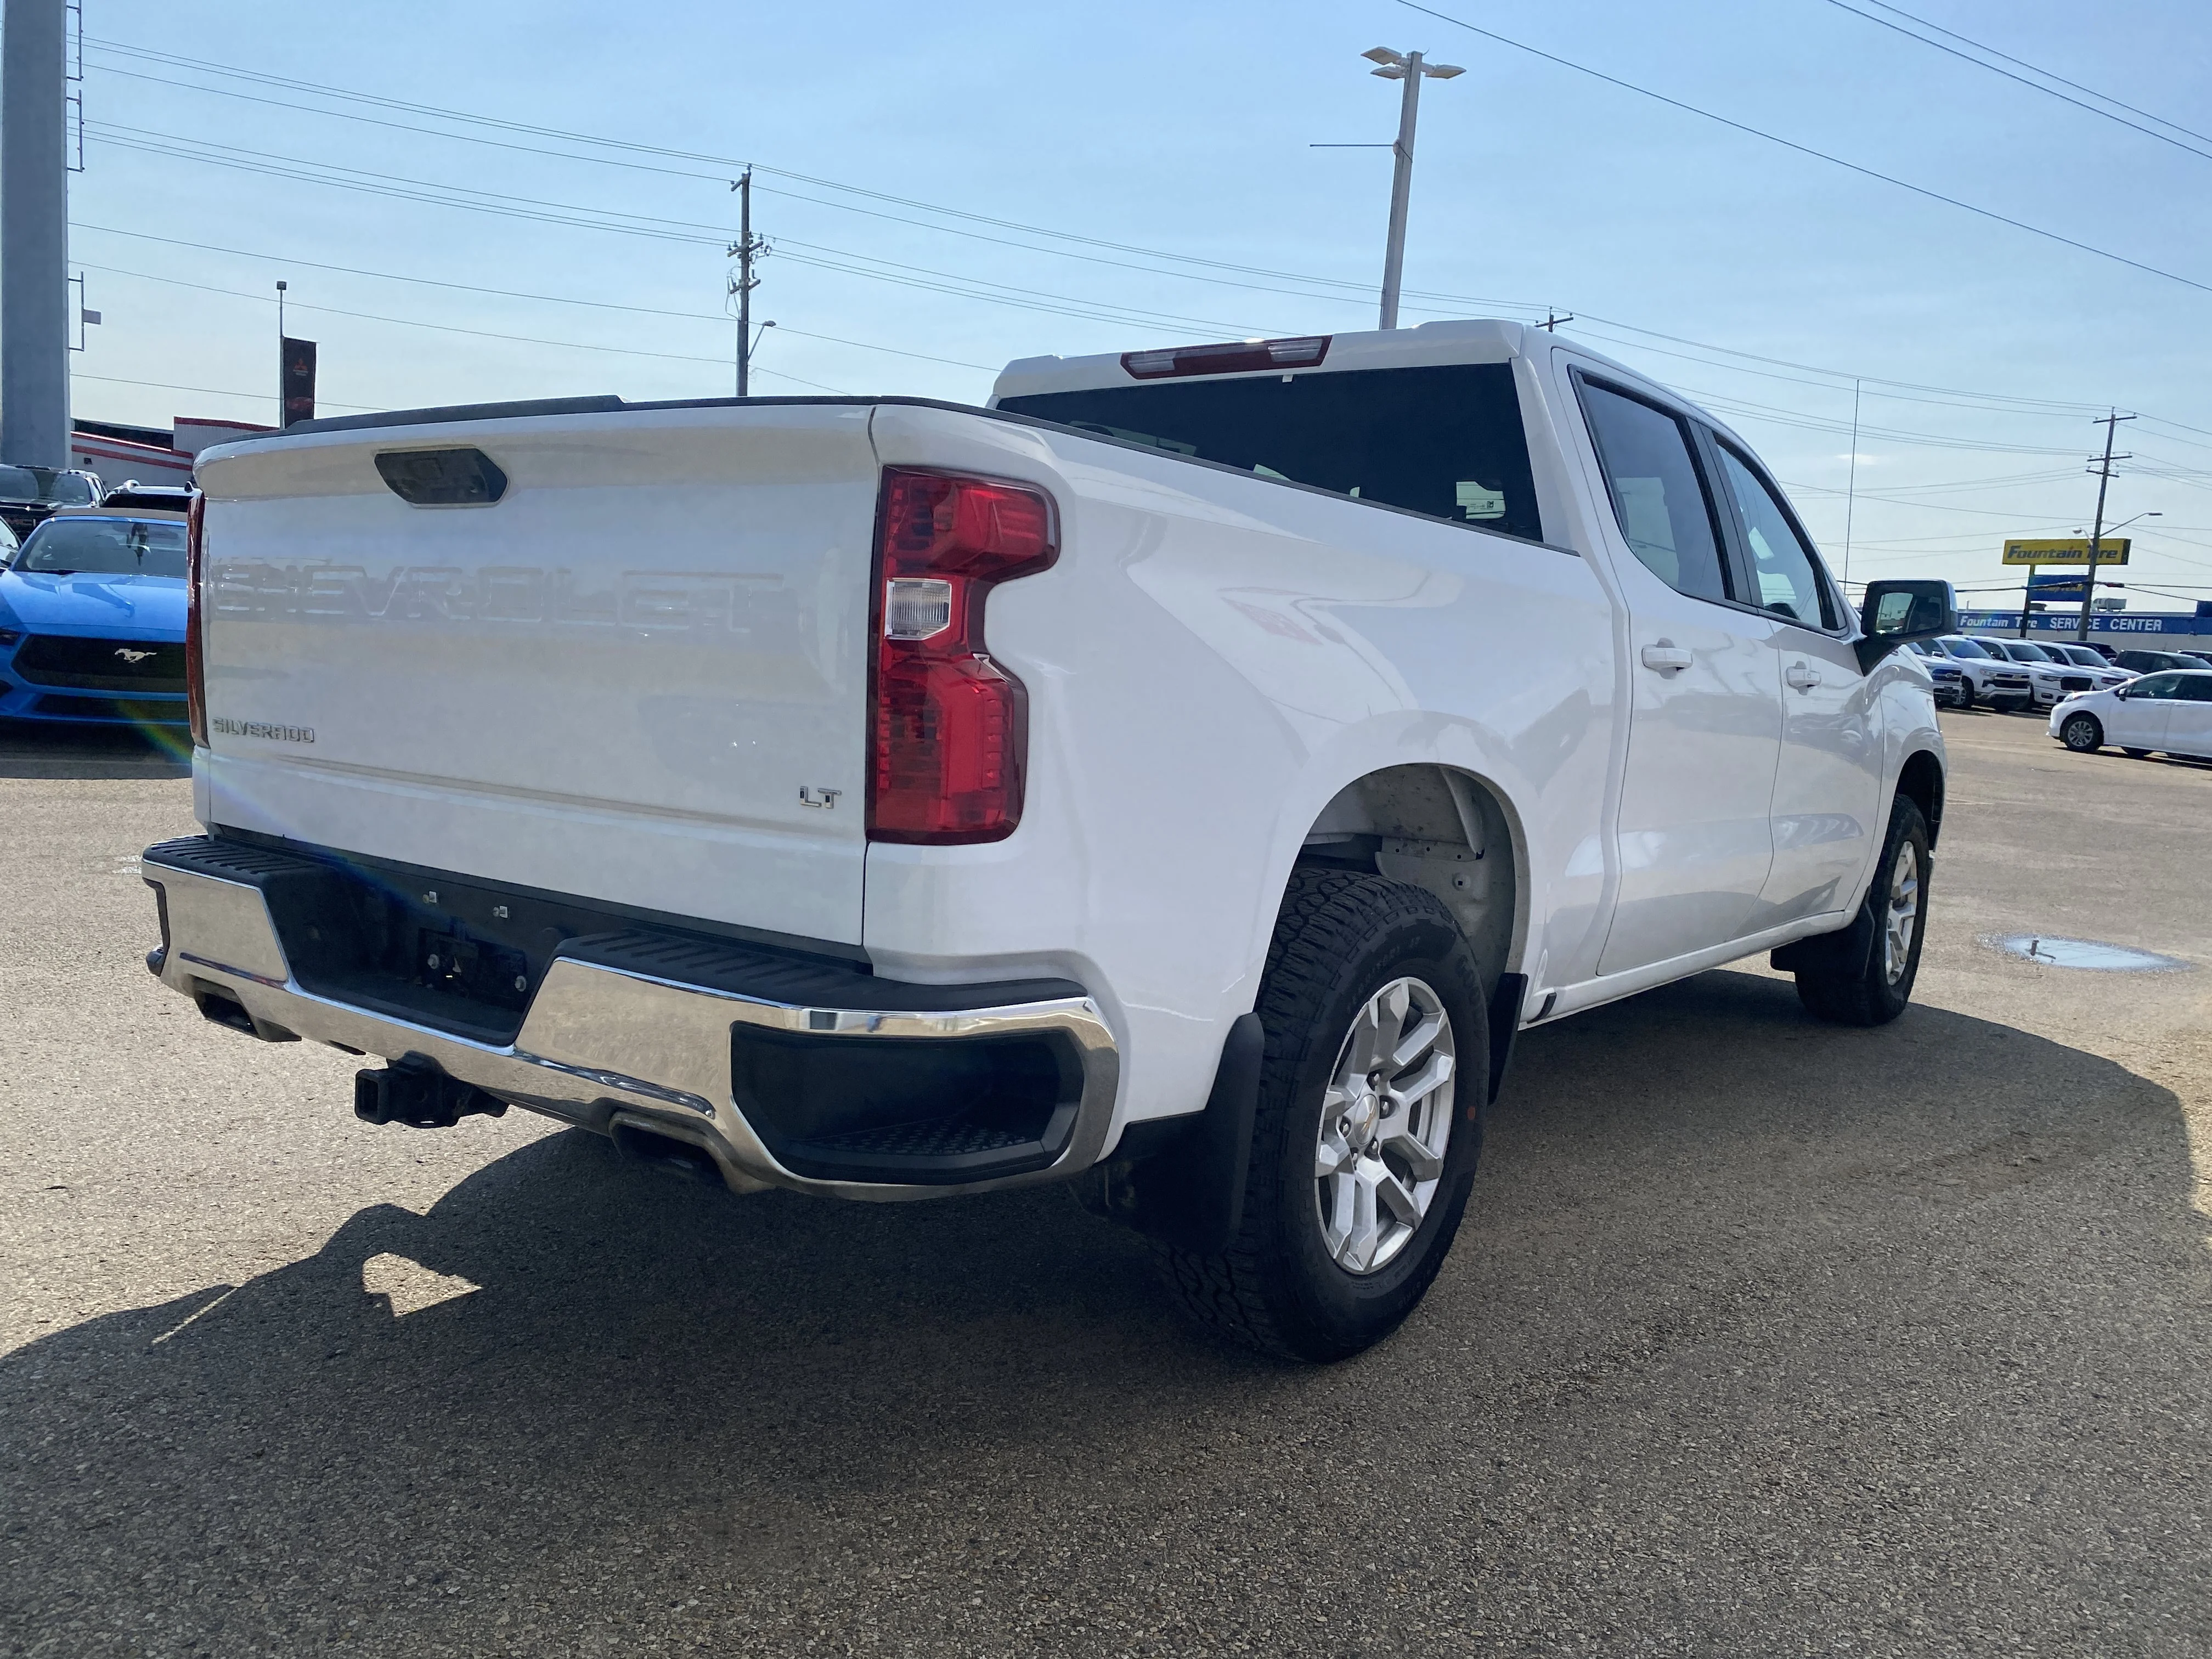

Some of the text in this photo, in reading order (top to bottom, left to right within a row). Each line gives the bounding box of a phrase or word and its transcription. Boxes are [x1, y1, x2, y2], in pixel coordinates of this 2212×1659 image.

[2008, 544, 2118, 558] Fountain Tre
[212, 565, 786, 633] CHEVROLET
[1960, 616, 2163, 631] Fountain Tre SERVE CENTER
[212, 717, 315, 743] SILVERADO
[800, 786, 842, 809] LT
